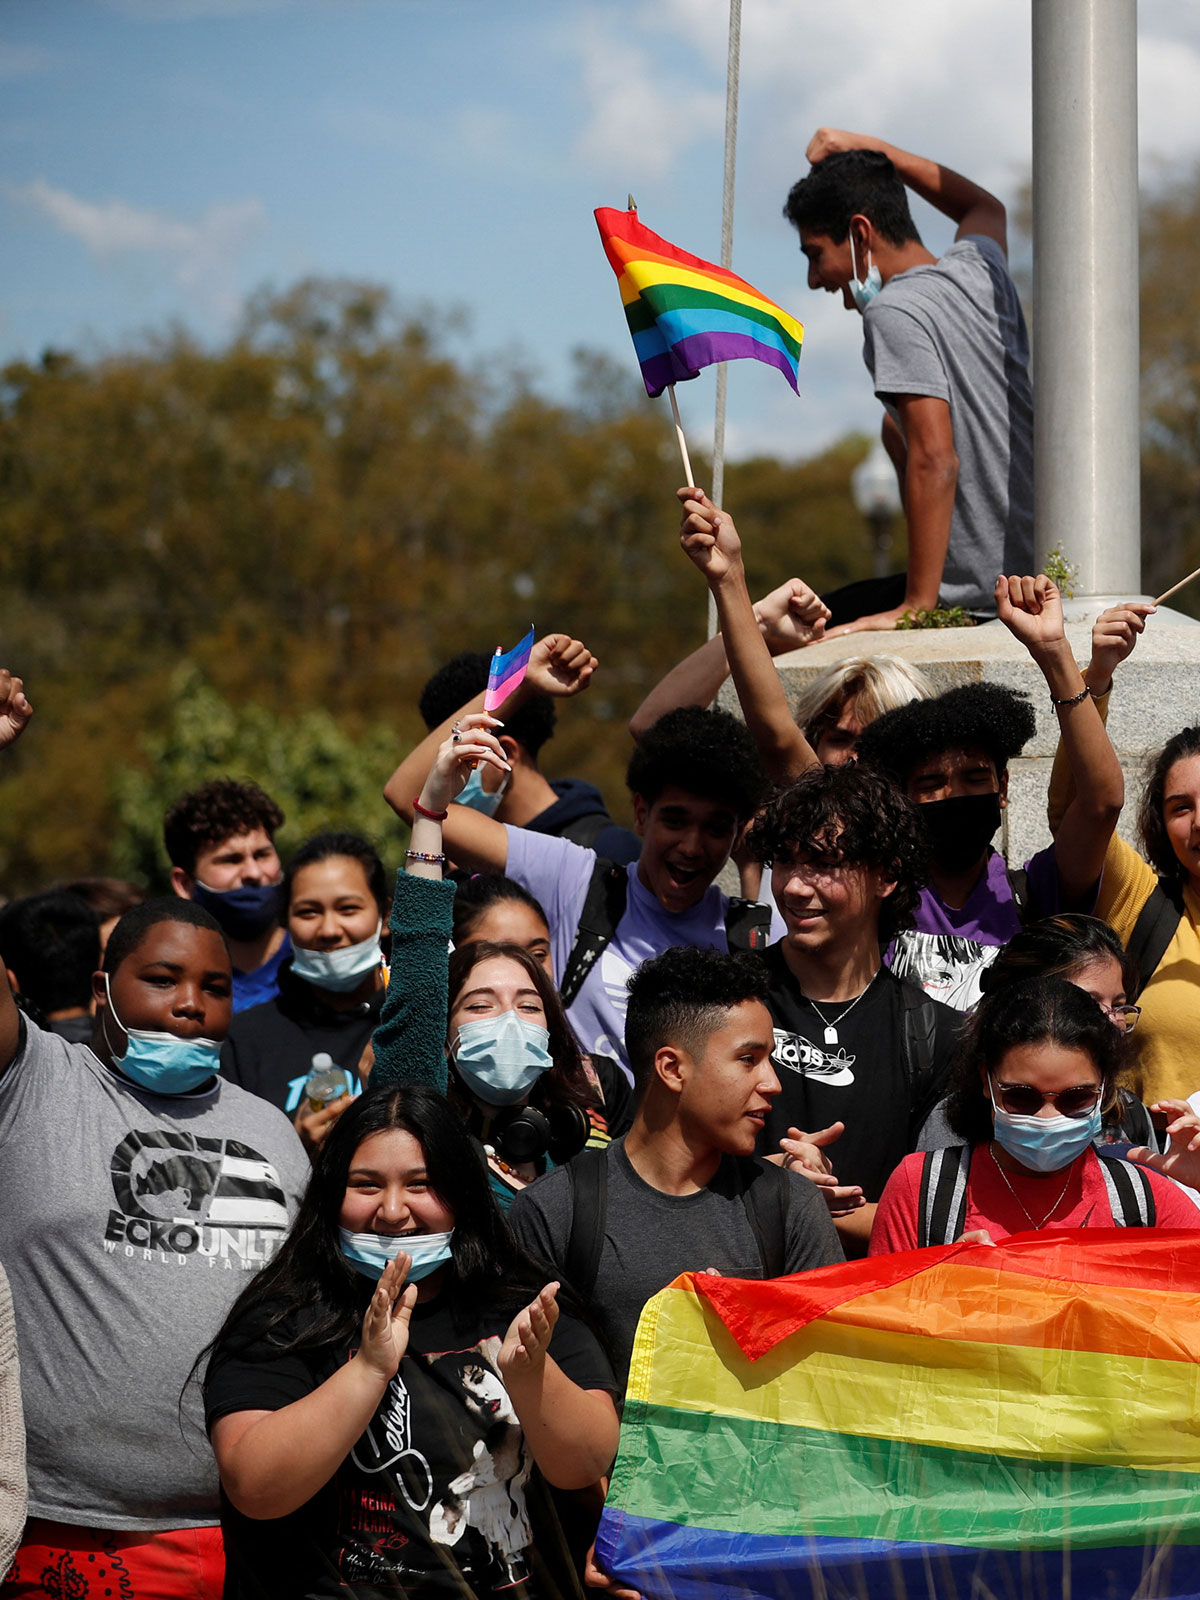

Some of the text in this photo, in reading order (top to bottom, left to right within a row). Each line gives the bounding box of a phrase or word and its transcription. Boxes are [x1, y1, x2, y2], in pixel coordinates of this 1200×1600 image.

[103, 1240, 187, 1266] WORLD
[195, 1226, 287, 1261] UNLT
[361, 1489, 396, 1512] REINA
